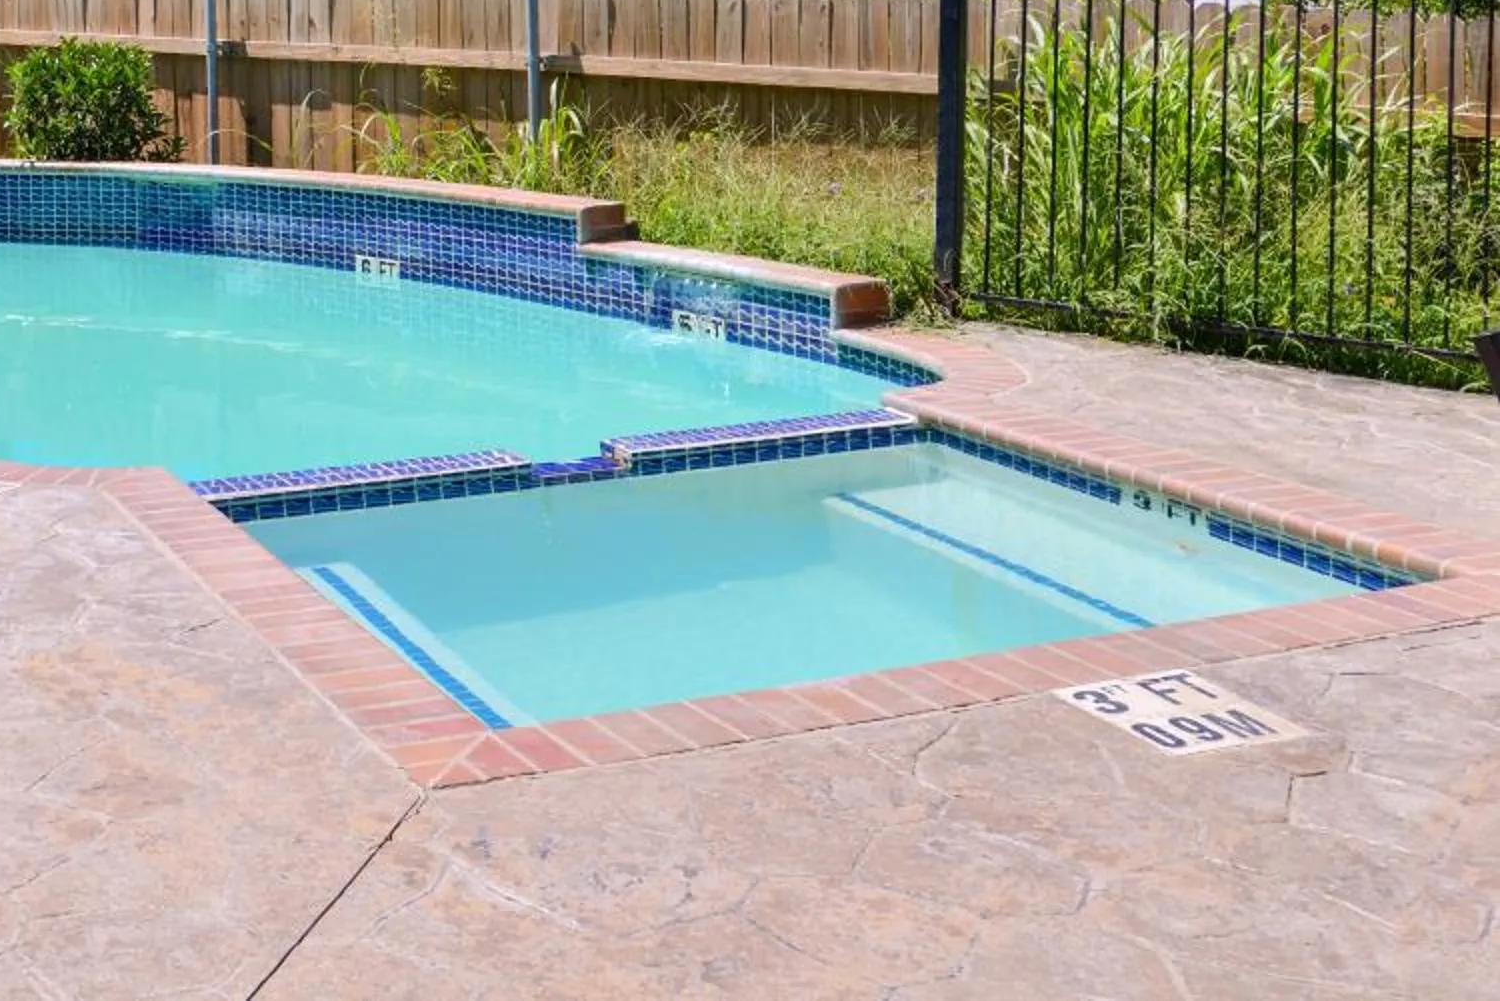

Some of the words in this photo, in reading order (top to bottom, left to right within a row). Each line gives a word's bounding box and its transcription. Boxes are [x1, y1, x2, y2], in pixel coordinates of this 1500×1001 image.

[379, 261, 397, 277] FT
[1073, 690, 1130, 714] 3
[1135, 673, 1219, 705] FT
